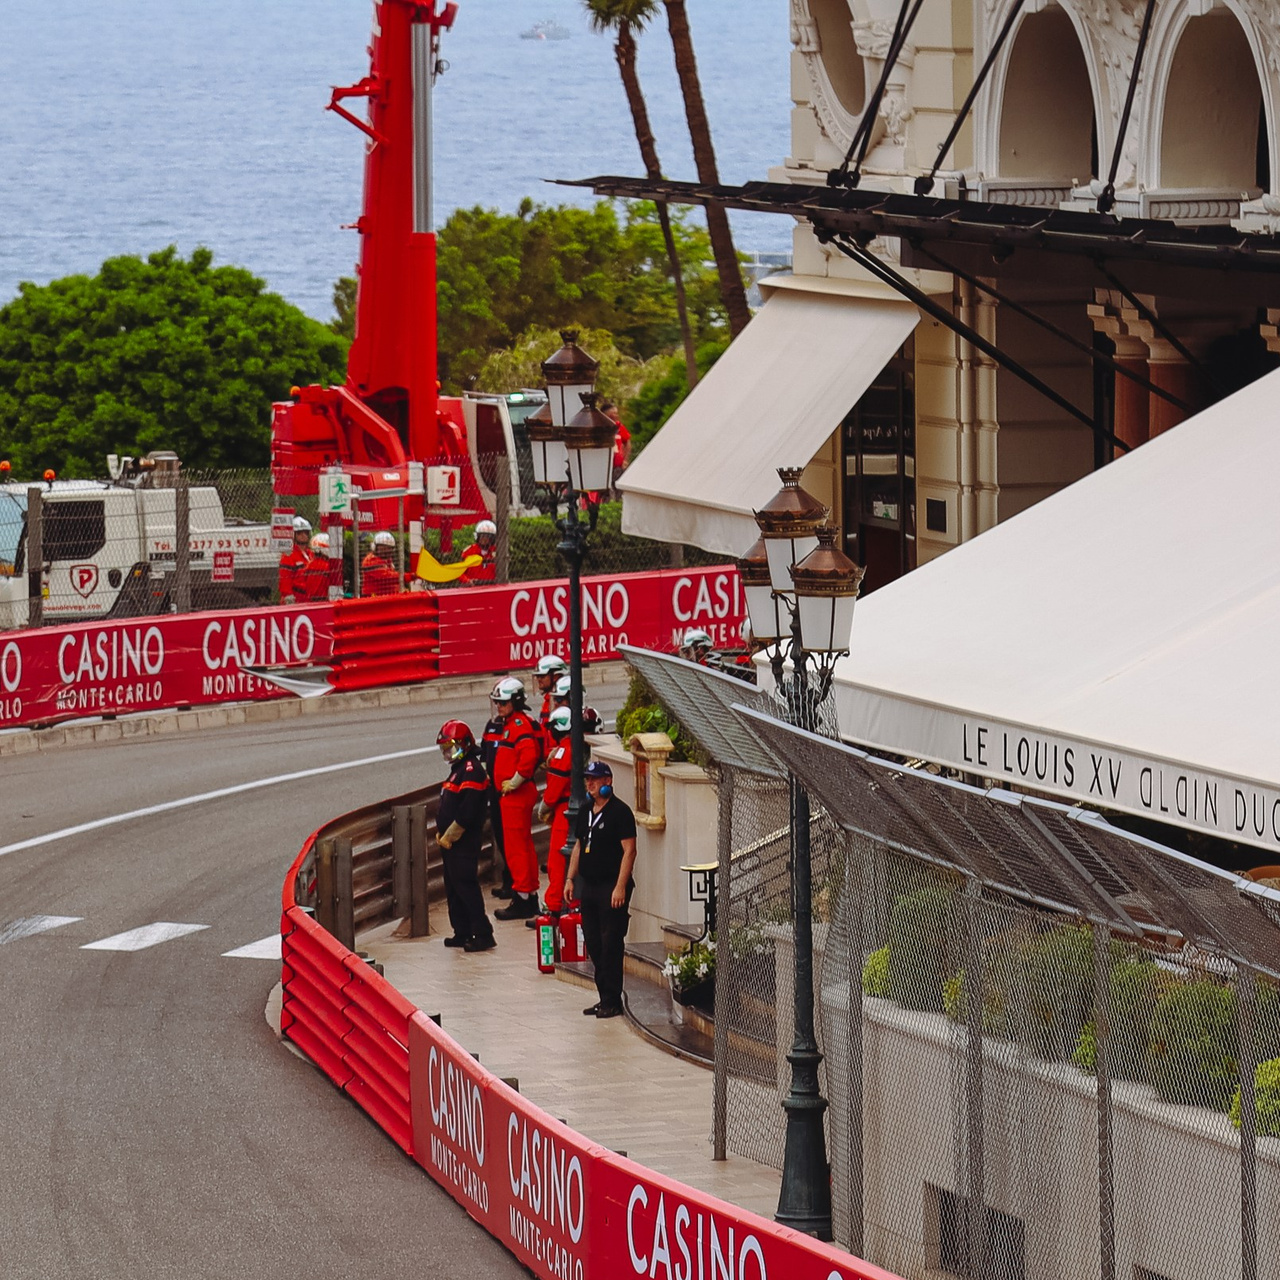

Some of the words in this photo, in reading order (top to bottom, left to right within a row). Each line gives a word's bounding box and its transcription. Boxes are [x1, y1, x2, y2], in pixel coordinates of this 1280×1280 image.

[510, 582, 630, 637] CASNO
[672, 573, 748, 622] CASI
[58, 626, 165, 684] CASINO
[202, 614, 315, 671] CASINO
[510, 638, 565, 661] MONTE
[115, 681, 163, 706] CARLO
[202, 672, 255, 695] MONTE
[963, 723, 988, 766] LE
[1003, 732, 1075, 788] LOUIS
[1089, 753, 1122, 799] XV
[428, 1045, 484, 1168] CASINO
[430, 1133, 459, 1182] MONTE
[461, 1161, 489, 1215] CARLO
[507, 1112, 585, 1245] CASINO
[509, 1204, 542, 1259] MONTE
